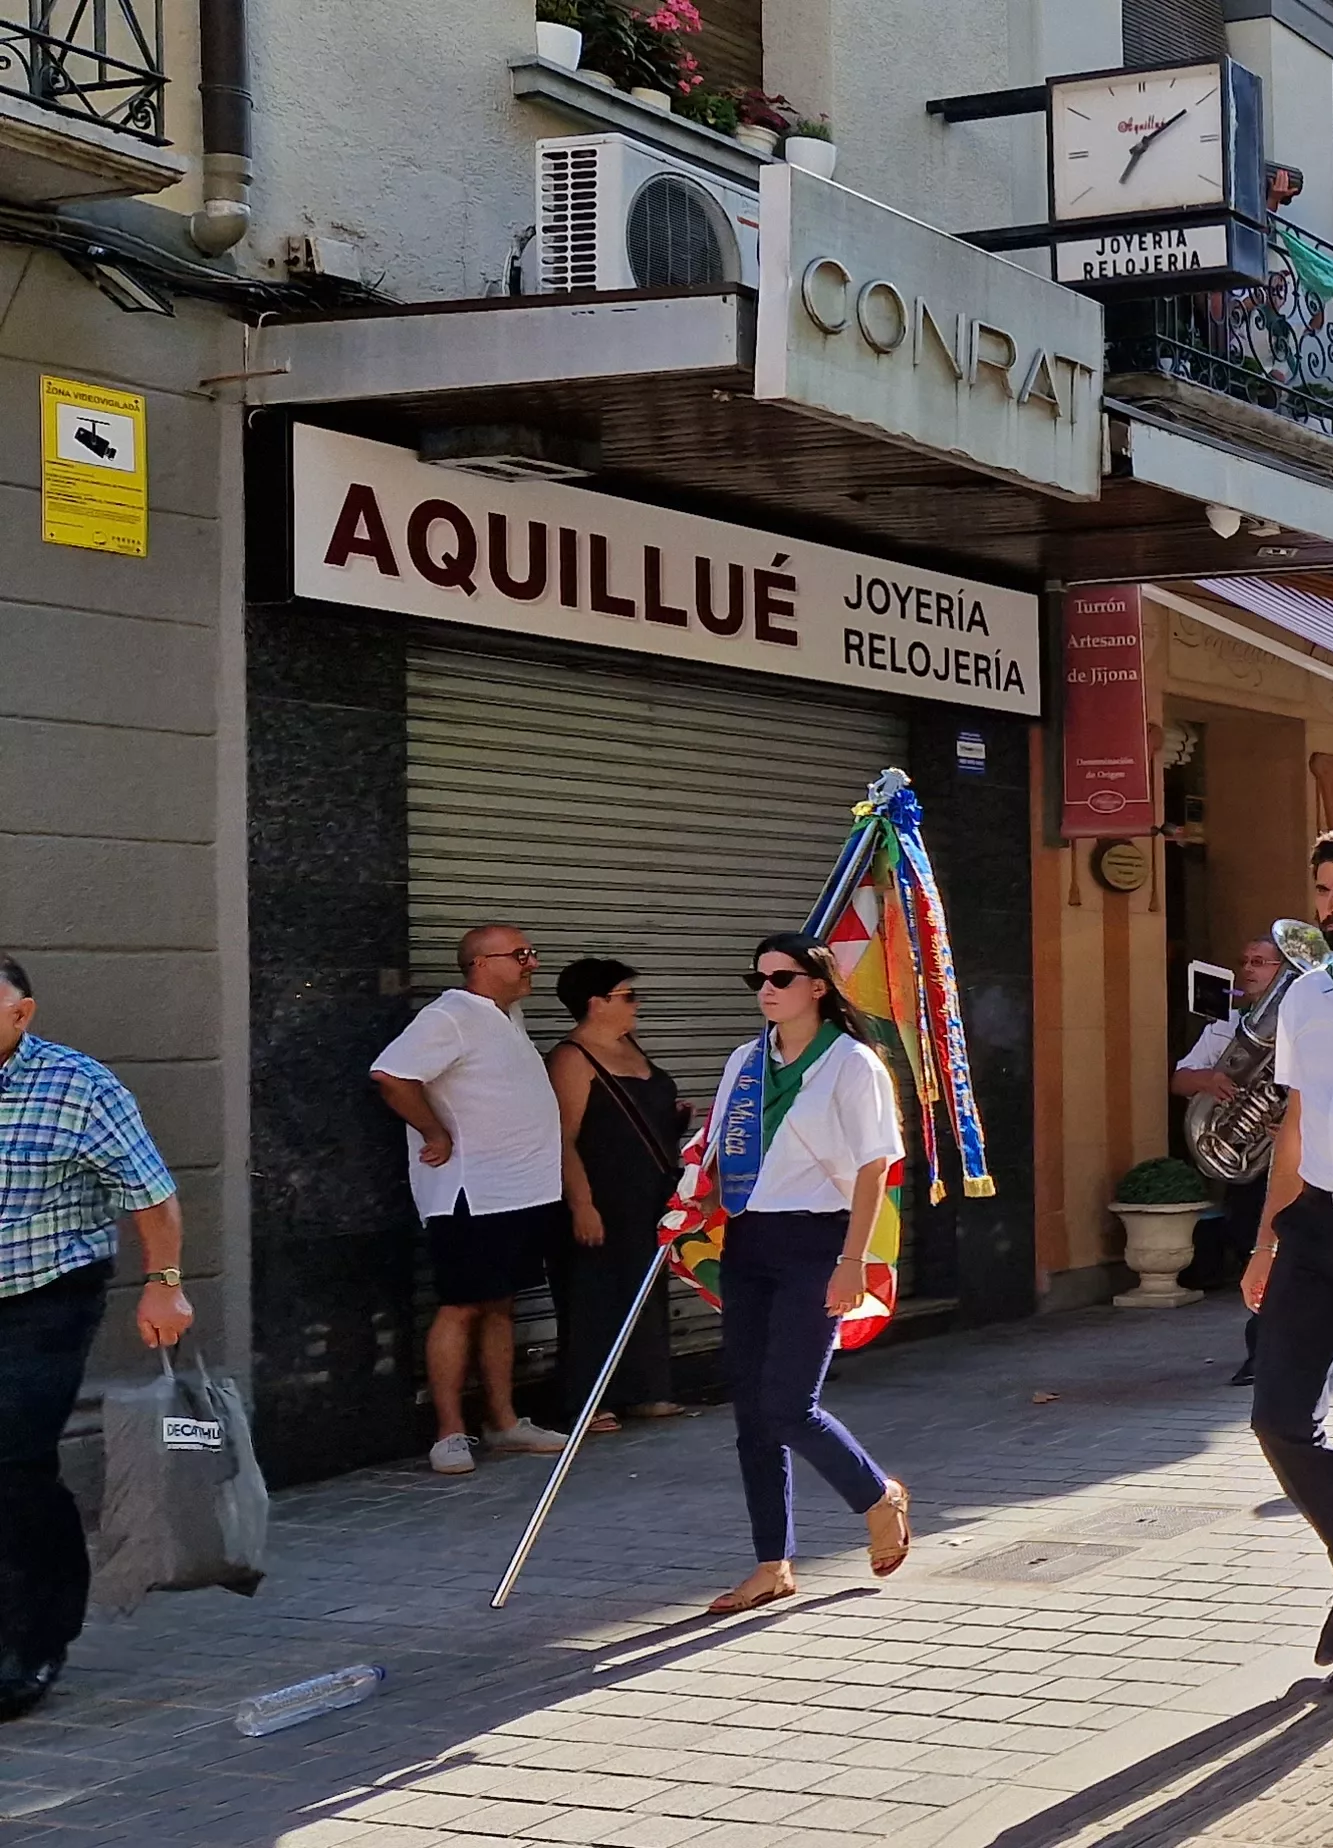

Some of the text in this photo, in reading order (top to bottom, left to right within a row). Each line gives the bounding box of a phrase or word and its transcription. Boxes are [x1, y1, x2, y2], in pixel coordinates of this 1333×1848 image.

[1096, 229, 1187, 256] JOYERIA
[1083, 250, 1201, 281] RELOJERIA
[801, 255, 1097, 425] CONRAT
[46, 385, 141, 412] ZONA VIDEOVIGILADA
[323, 482, 799, 647] AQUILLUÉ
[843, 573, 990, 637] JOYERÍA
[1074, 597, 1126, 614] Turrón
[1067, 634, 1137, 649] Artesano
[843, 627, 1026, 696] RELOJERÍA
[1067, 666, 1138, 686] de Jijona
[735, 1074, 761, 1092] de
[166, 1424, 221, 1440] DECATHL
